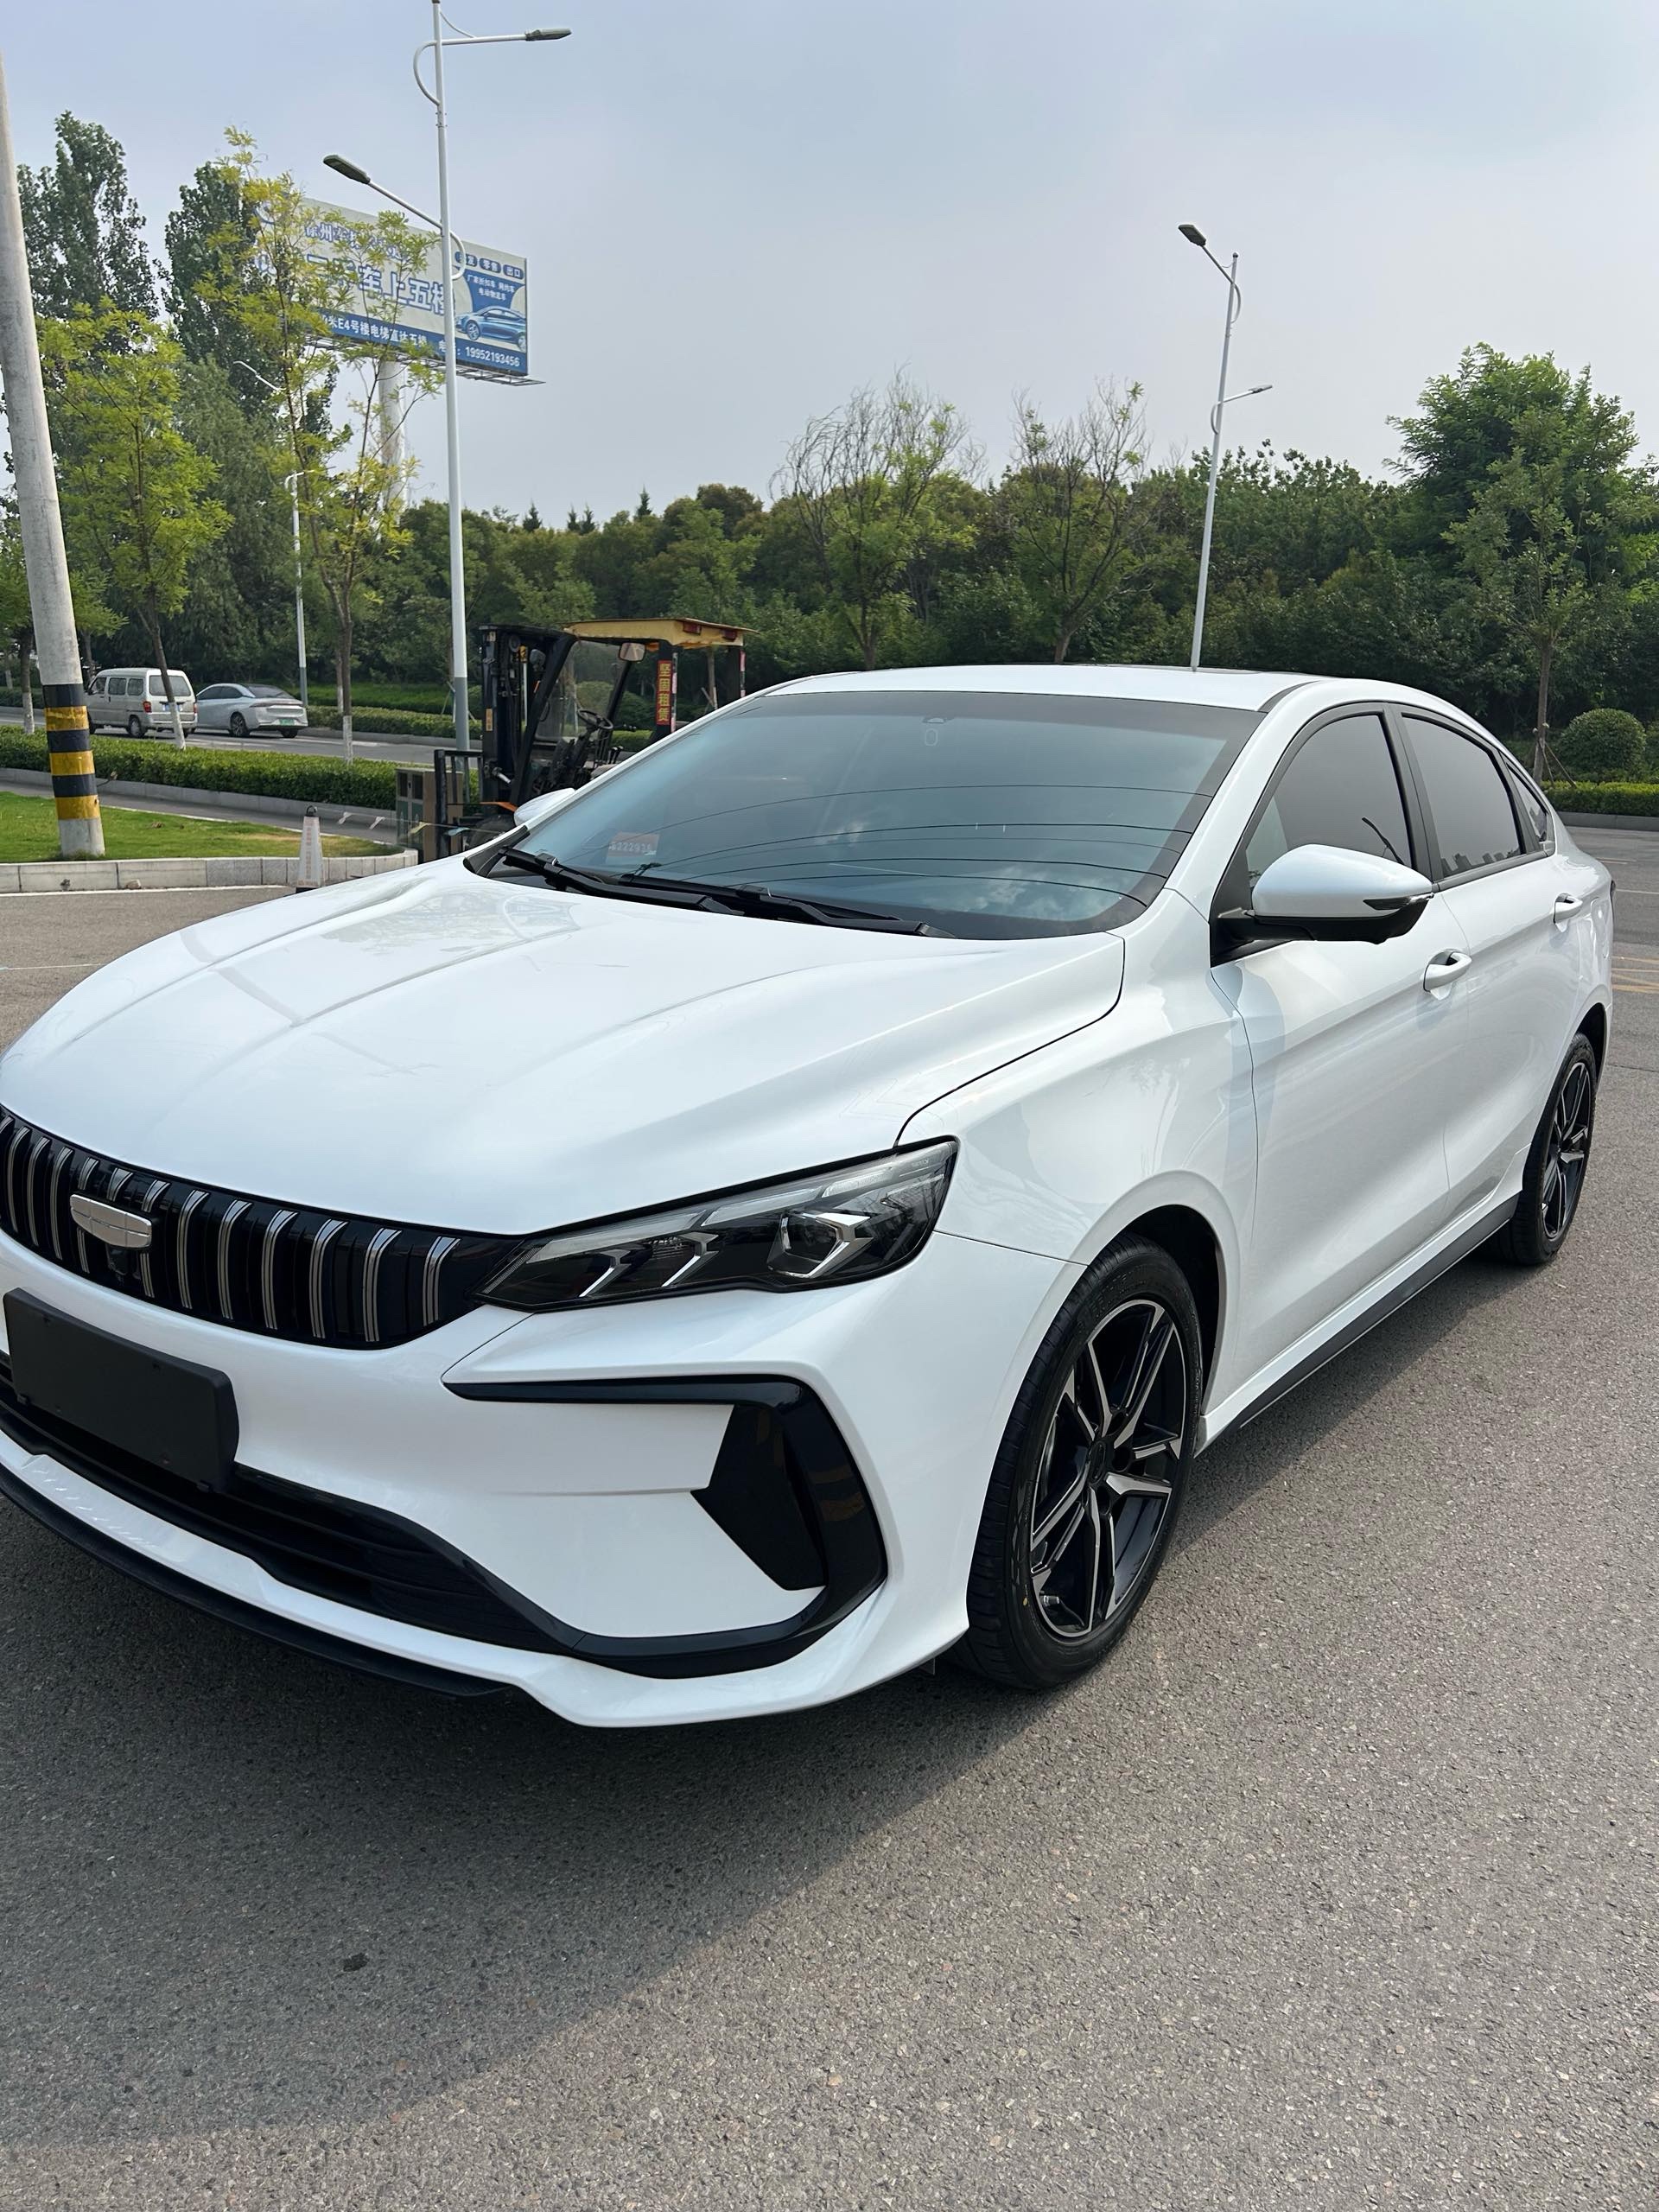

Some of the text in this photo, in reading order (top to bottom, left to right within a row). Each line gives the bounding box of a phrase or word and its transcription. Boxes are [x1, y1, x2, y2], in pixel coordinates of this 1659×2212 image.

[506, 265, 520, 277] 出口
[465, 346, 520, 367] 19952193456
[658, 663, 671, 721] 坚固租赁
